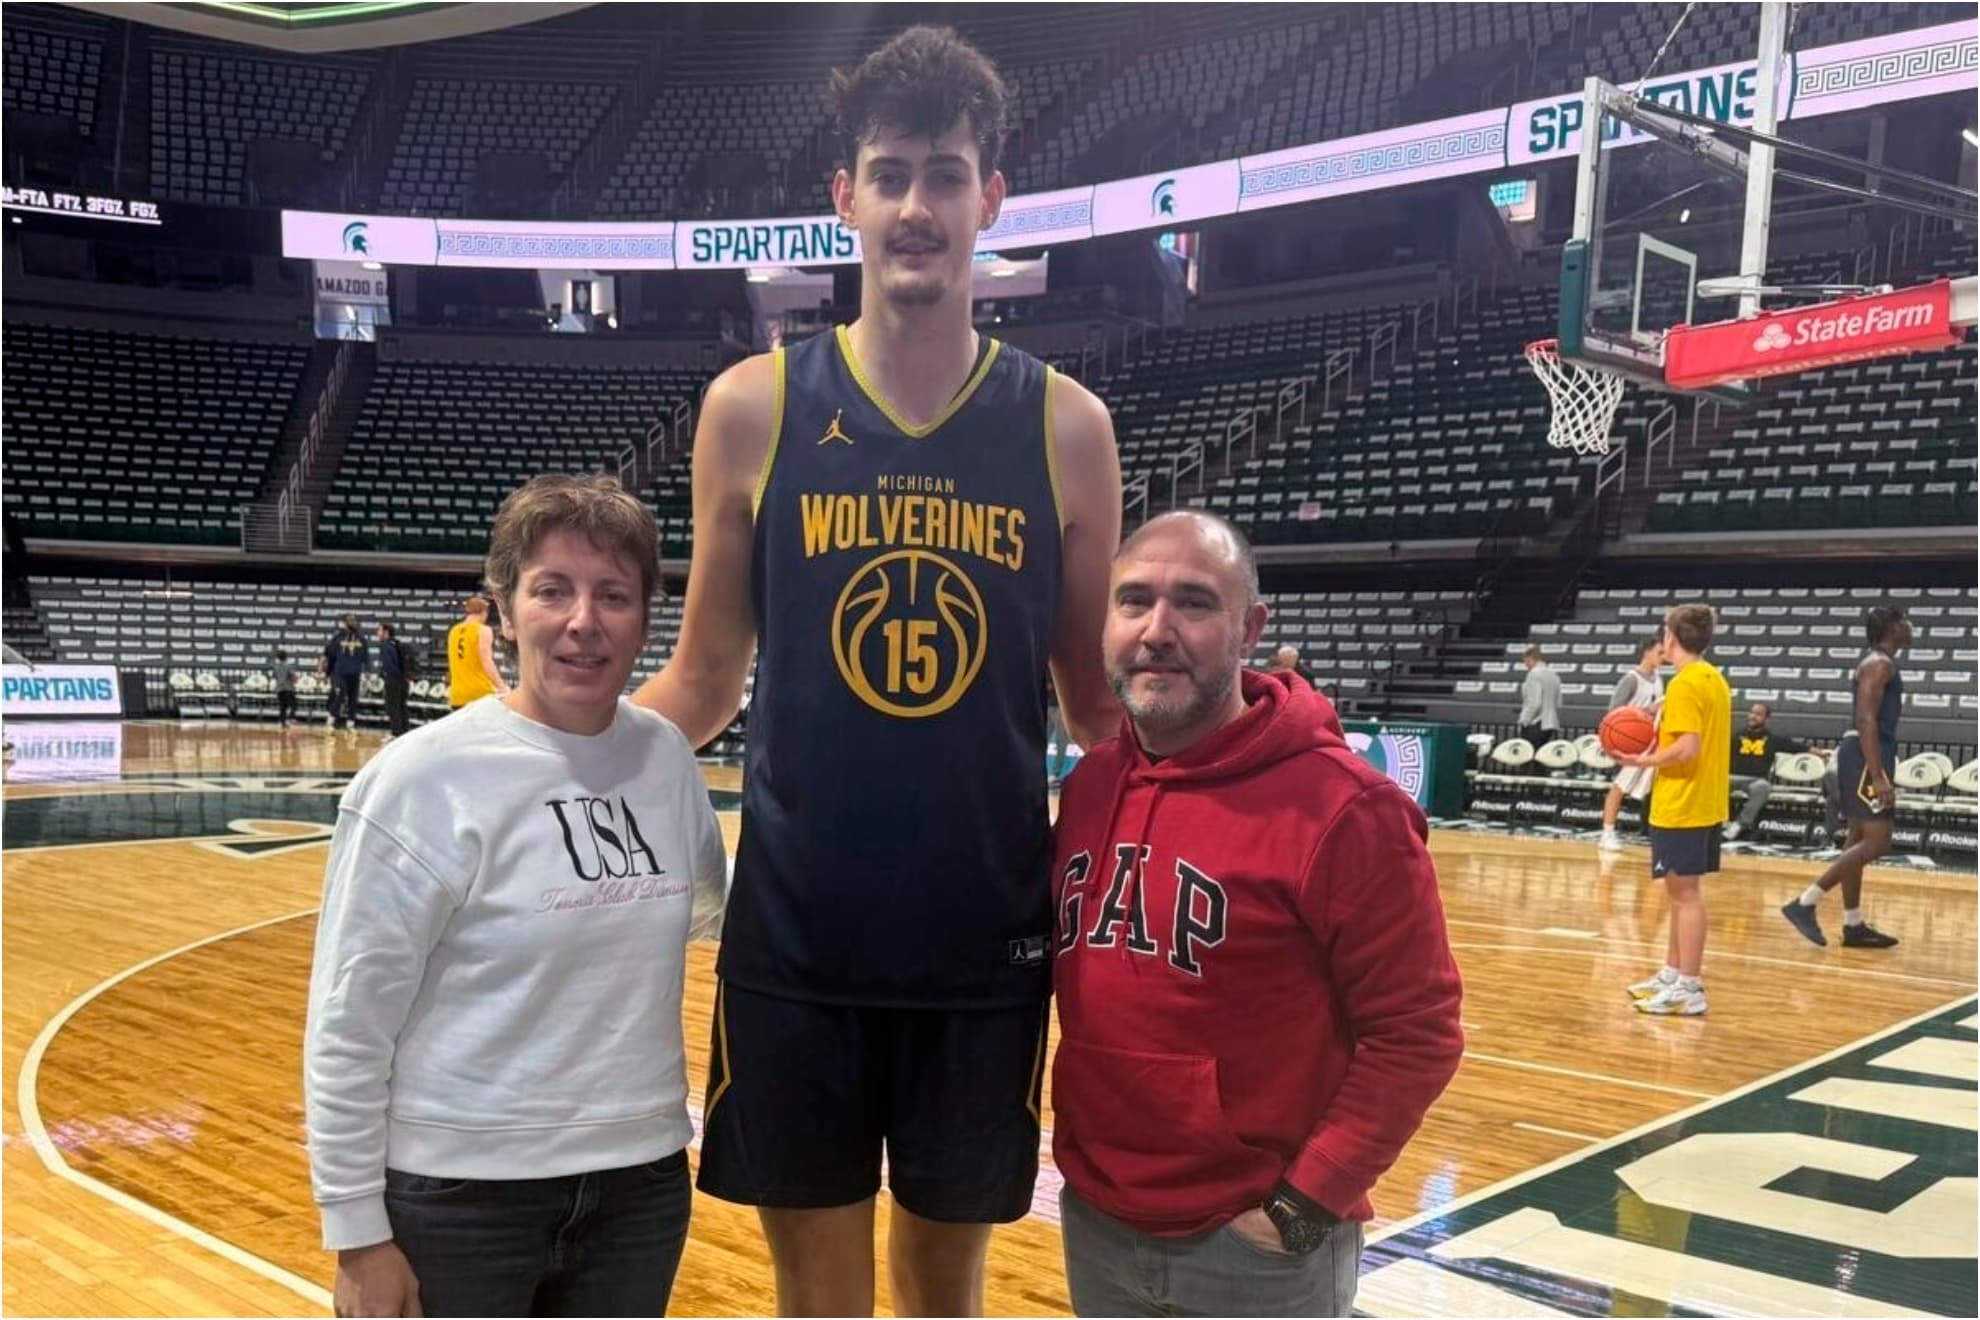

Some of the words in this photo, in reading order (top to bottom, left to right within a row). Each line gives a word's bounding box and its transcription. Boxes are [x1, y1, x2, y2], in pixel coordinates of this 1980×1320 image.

[53, 193, 82, 211] FT%
[86, 196, 124, 215] 3FG%
[129, 201, 159, 218] FG%
[693, 222, 854, 262] SPARTANS
[877, 475, 955, 494] MICHIGAN
[801, 494, 1026, 572] WOLVERINES
[883, 618, 938, 695] 15
[1739, 737, 1767, 756] M
[545, 796, 666, 881] USA
[1768, 821, 1807, 834] Rocket
[1056, 843, 1228, 977] GAP
